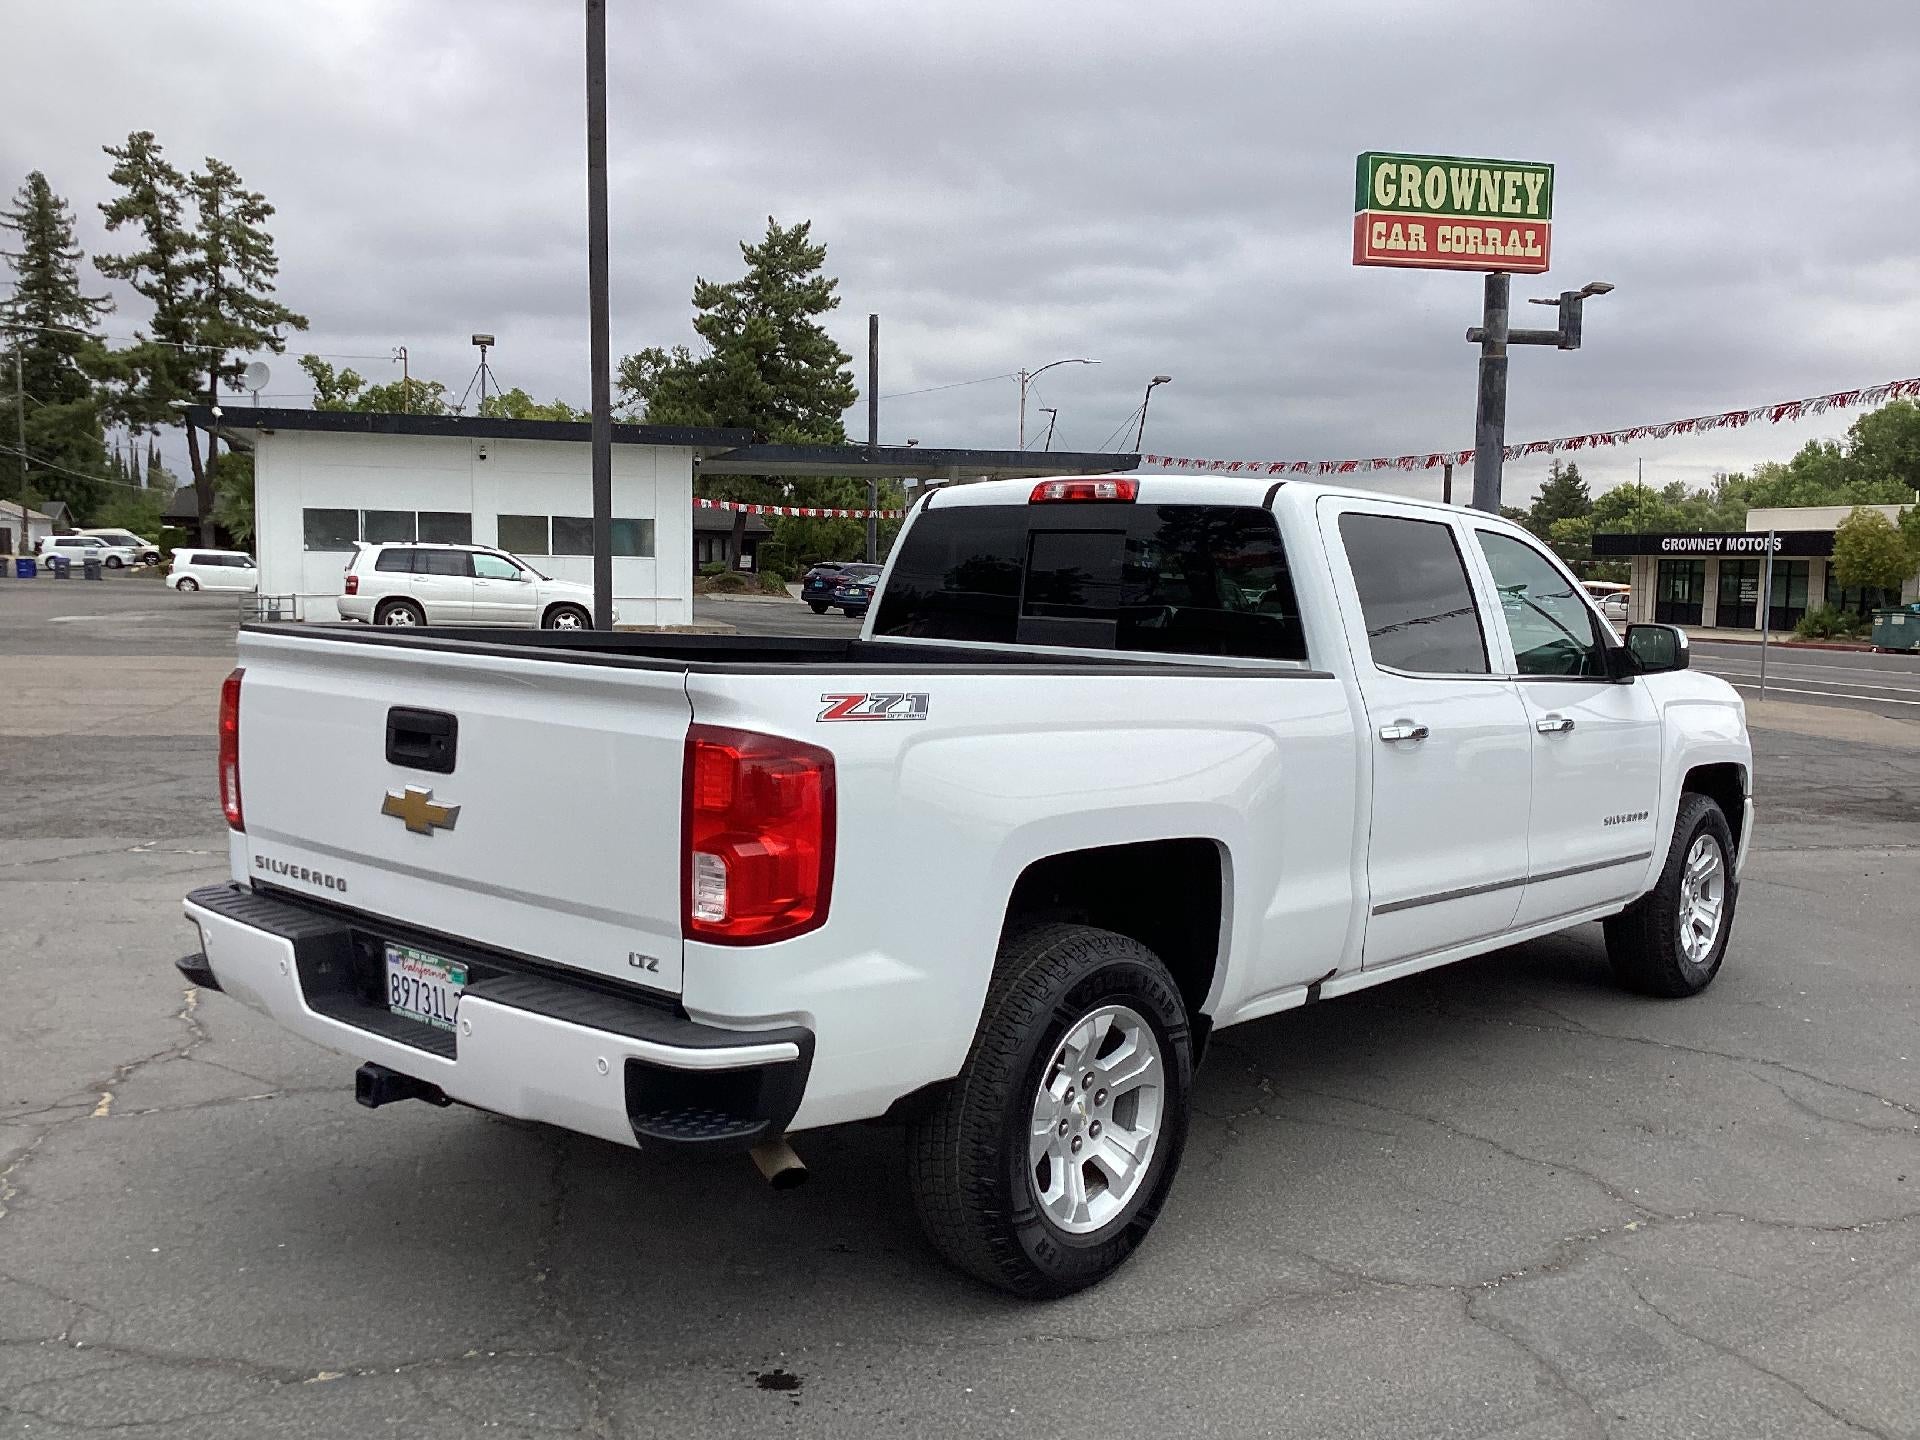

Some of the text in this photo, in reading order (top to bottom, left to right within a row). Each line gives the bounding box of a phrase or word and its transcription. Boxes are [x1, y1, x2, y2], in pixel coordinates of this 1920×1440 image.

[1374, 161, 1545, 215] GROWNEY
[1372, 221, 1542, 257] CAR CORRAL
[1661, 537, 1782, 551] GROWNEY MOTORS
[815, 692, 930, 722] Z71
[1603, 811, 1649, 826] SILVERADO
[255, 855, 347, 892] SILVERADO
[402, 958, 447, 981] California
[628, 951, 659, 973] LTZ
